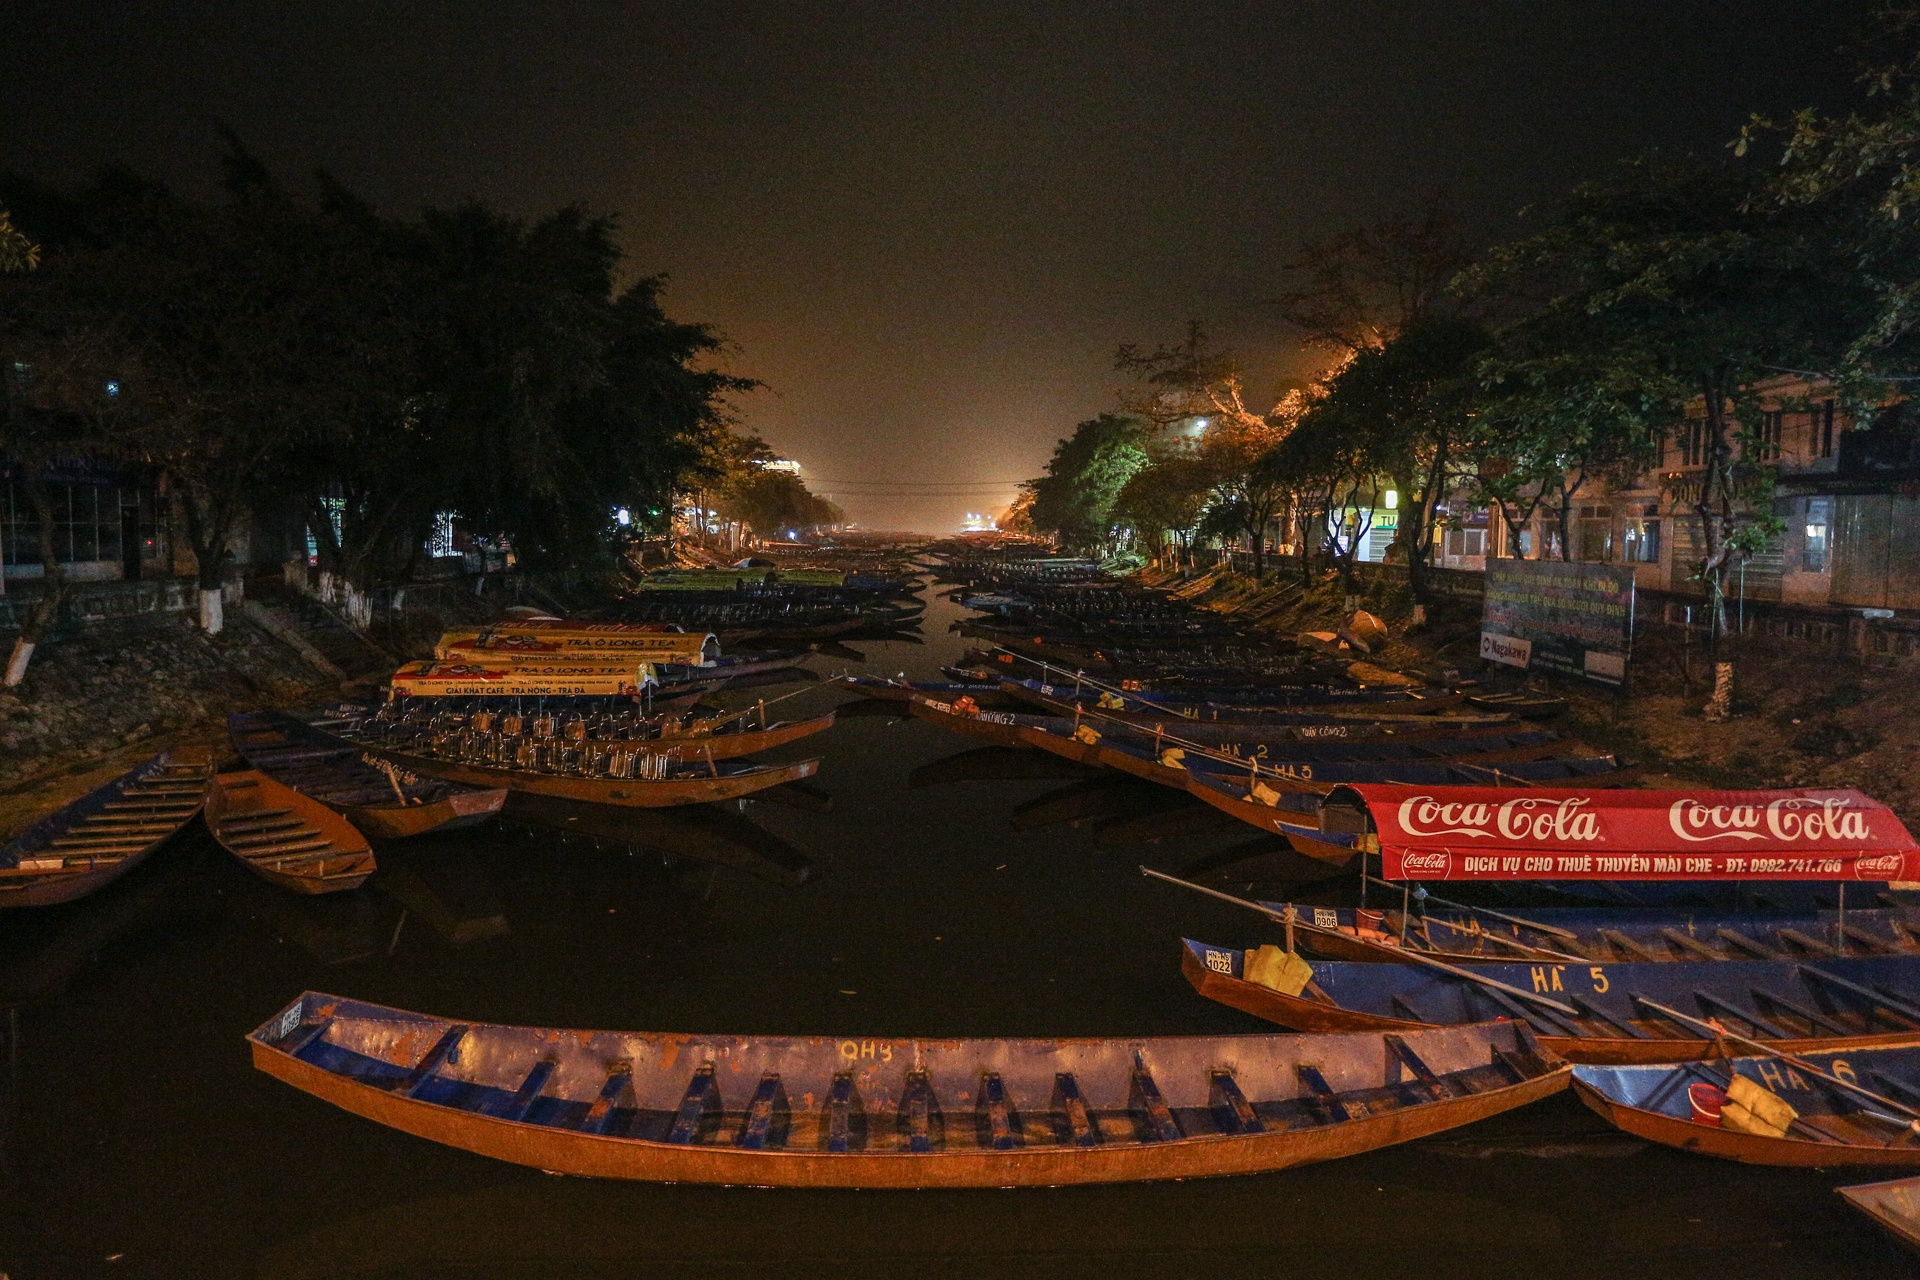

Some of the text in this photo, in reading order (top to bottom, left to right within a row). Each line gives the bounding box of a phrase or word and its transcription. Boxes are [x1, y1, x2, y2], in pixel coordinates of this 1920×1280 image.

[609, 639, 645, 647] LONG
[650, 639, 676, 647] TEA
[1491, 639, 1527, 661] Nagakawa
[1009, 713, 1016, 726] 2
[1340, 726, 1348, 738] 2
[1256, 744, 1268, 759] 2
[1398, 796, 1600, 841] Coca-Cola
[1669, 798, 1870, 841] Coca-Cola
[1404, 853, 1448, 868] Coca-Cola
[1464, 856, 1498, 874] DỊCH
[1502, 857, 1520, 875] VỤ
[1524, 857, 1553, 872] CHO
[1557, 854, 1592, 872] THUÊ
[1596, 853, 1650, 873] THUYỀN
[1685, 857, 1713, 872] CHE
[1726, 858, 1747, 872] ĐT:
[1750, 858, 1842, 873] 0982.741.766
[1856, 855, 1900, 870] Coca-Cola
[1316, 917, 1337, 927] 0906
[1208, 960, 1231, 972] 1022
[1590, 967, 1610, 993] 5
[1832, 1059, 1858, 1086] 6
